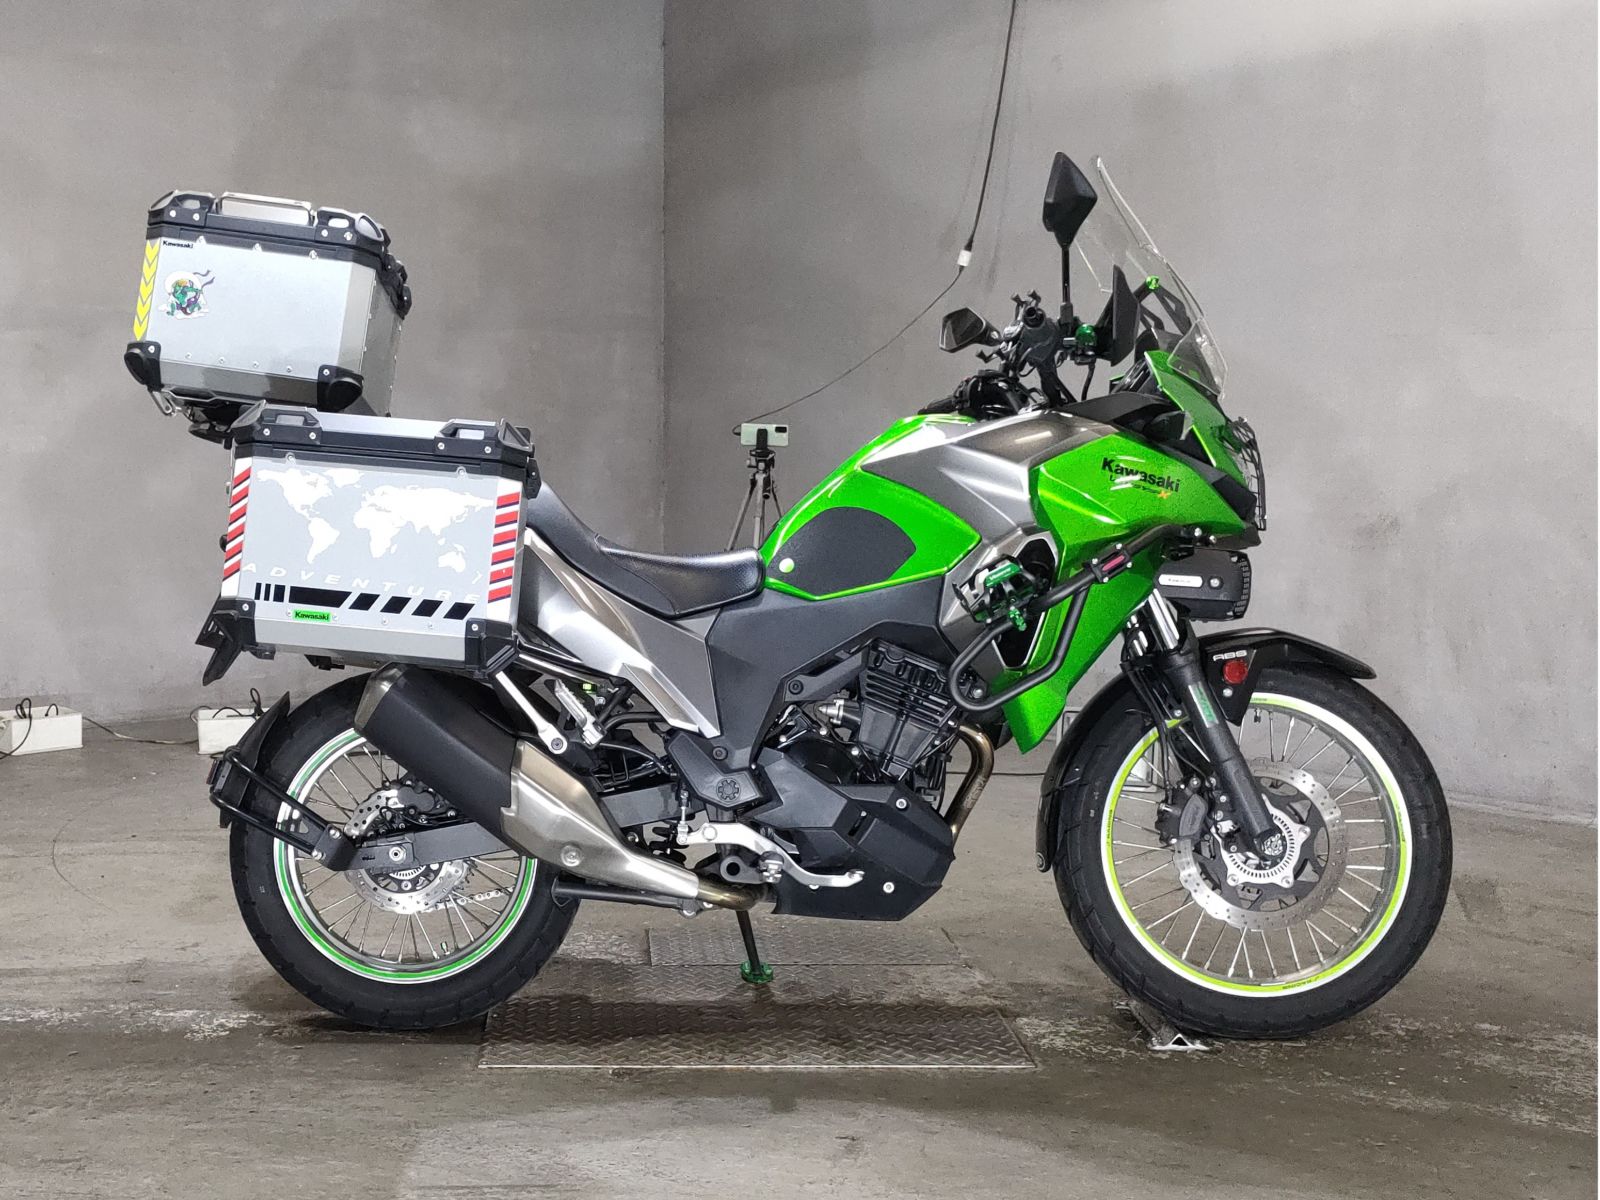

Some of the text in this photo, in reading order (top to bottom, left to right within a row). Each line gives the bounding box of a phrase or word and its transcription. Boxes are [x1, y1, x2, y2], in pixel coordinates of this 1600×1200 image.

[1101, 457, 1181, 493] Kawasaki
[242, 562, 481, 605] ADVENTURE
[294, 610, 329, 621] Kawasaki
[1212, 649, 1248, 662] ABS
